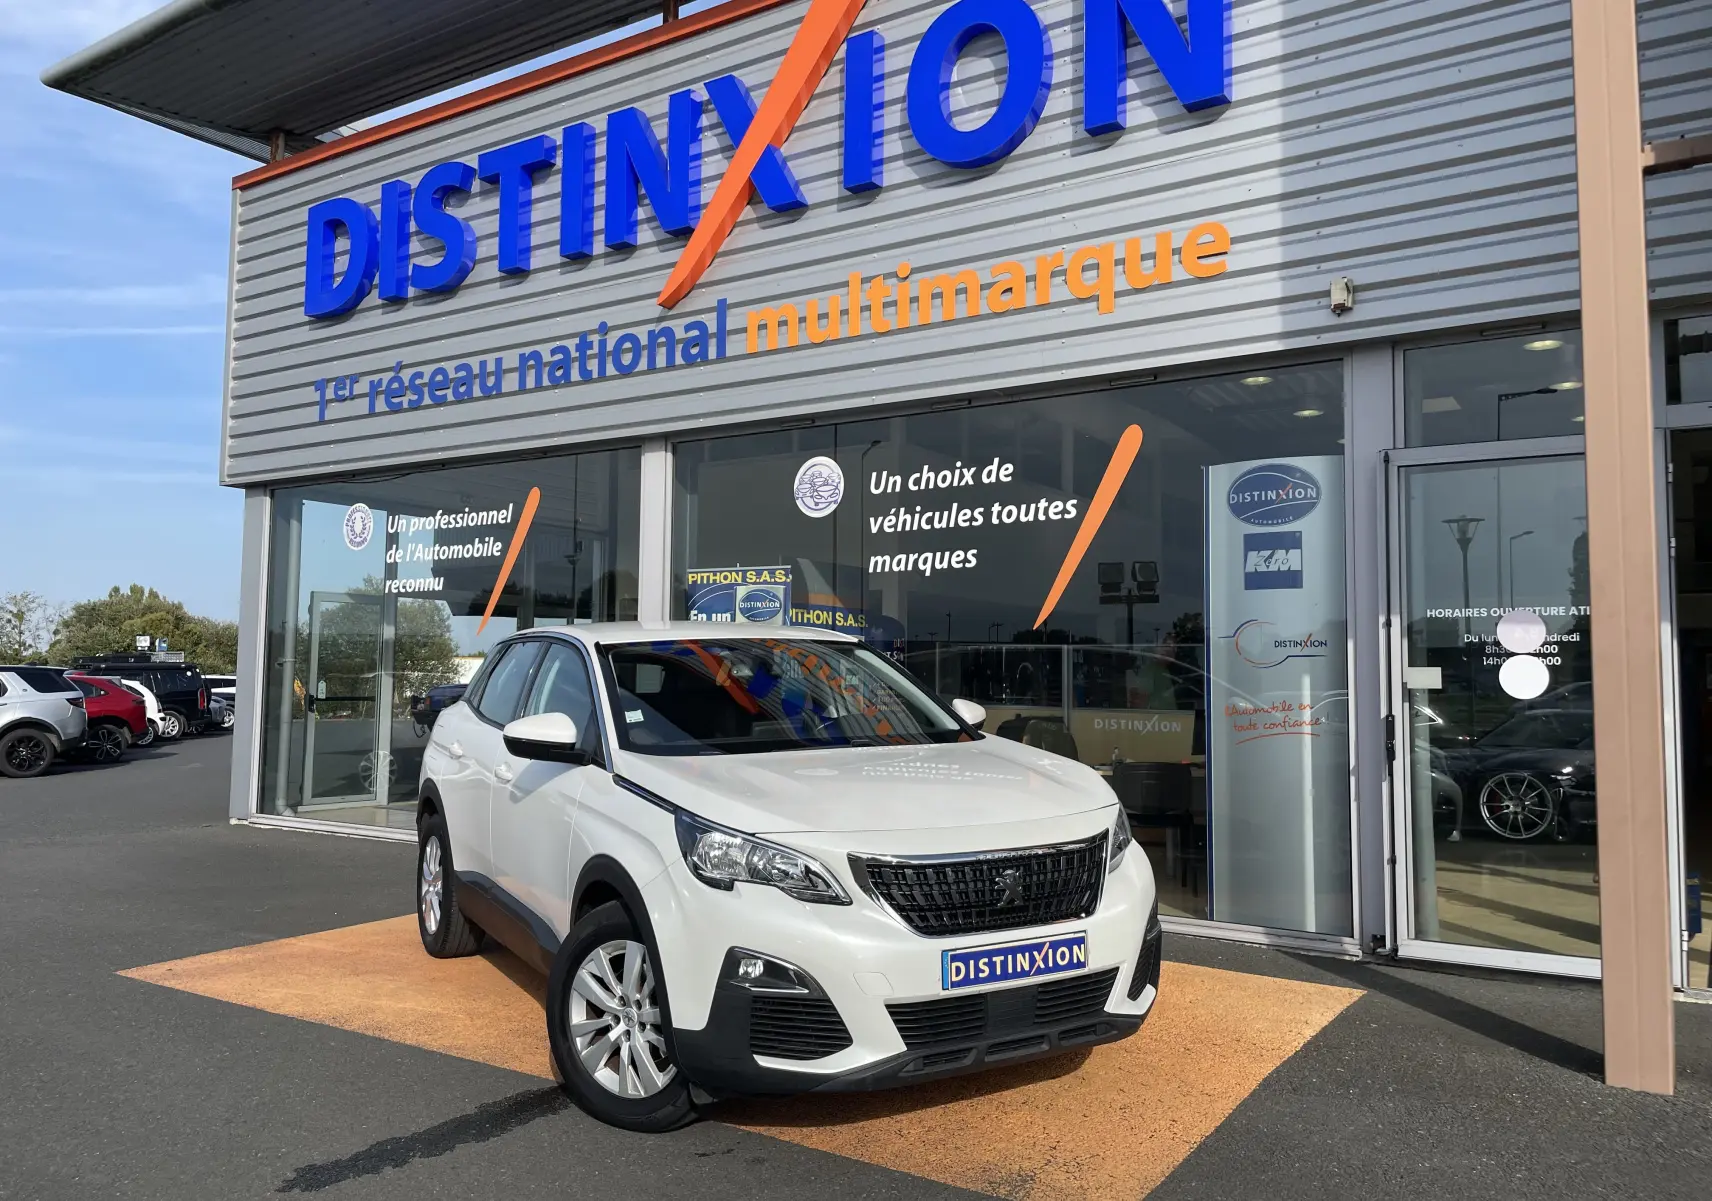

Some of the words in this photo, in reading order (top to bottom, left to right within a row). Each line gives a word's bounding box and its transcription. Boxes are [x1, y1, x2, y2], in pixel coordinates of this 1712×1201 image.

[304, 0, 1232, 318] DISTINXION
[314, 374, 359, 421] 1er
[369, 360, 503, 414] réseau
[518, 297, 728, 391] national
[745, 221, 1231, 354] multimarque
[870, 470, 902, 494] Un
[908, 461, 977, 491] choix
[981, 457, 1014, 484] de
[1230, 482, 1316, 504] DISTINXION
[387, 515, 406, 533] Un
[408, 503, 513, 537] professionnel
[869, 503, 984, 533] véhicules
[991, 497, 1078, 526] toutes
[386, 545, 403, 563] de
[406, 537, 502, 562] l'Automobile
[869, 549, 978, 576] marques
[385, 577, 444, 594] reconnu
[689, 572, 742, 585] PITHON
[740, 599, 780, 609] DISTINXION
[1427, 608, 1488, 618] HORAIRES
[1490, 606, 1566, 617] OUTURE
[691, 609, 707, 621] En
[790, 608, 833, 625] ITHON
[835, 612, 869, 628] S.A.S.
[1274, 633, 1328, 652] DISTINXION
[1464, 634, 1479, 642] Du
[1094, 714, 1181, 735] DISTINXION
[1233, 718, 1259, 732] toute
[1263, 715, 1322, 731] confiance
[951, 942, 1086, 982] DISTINXION
